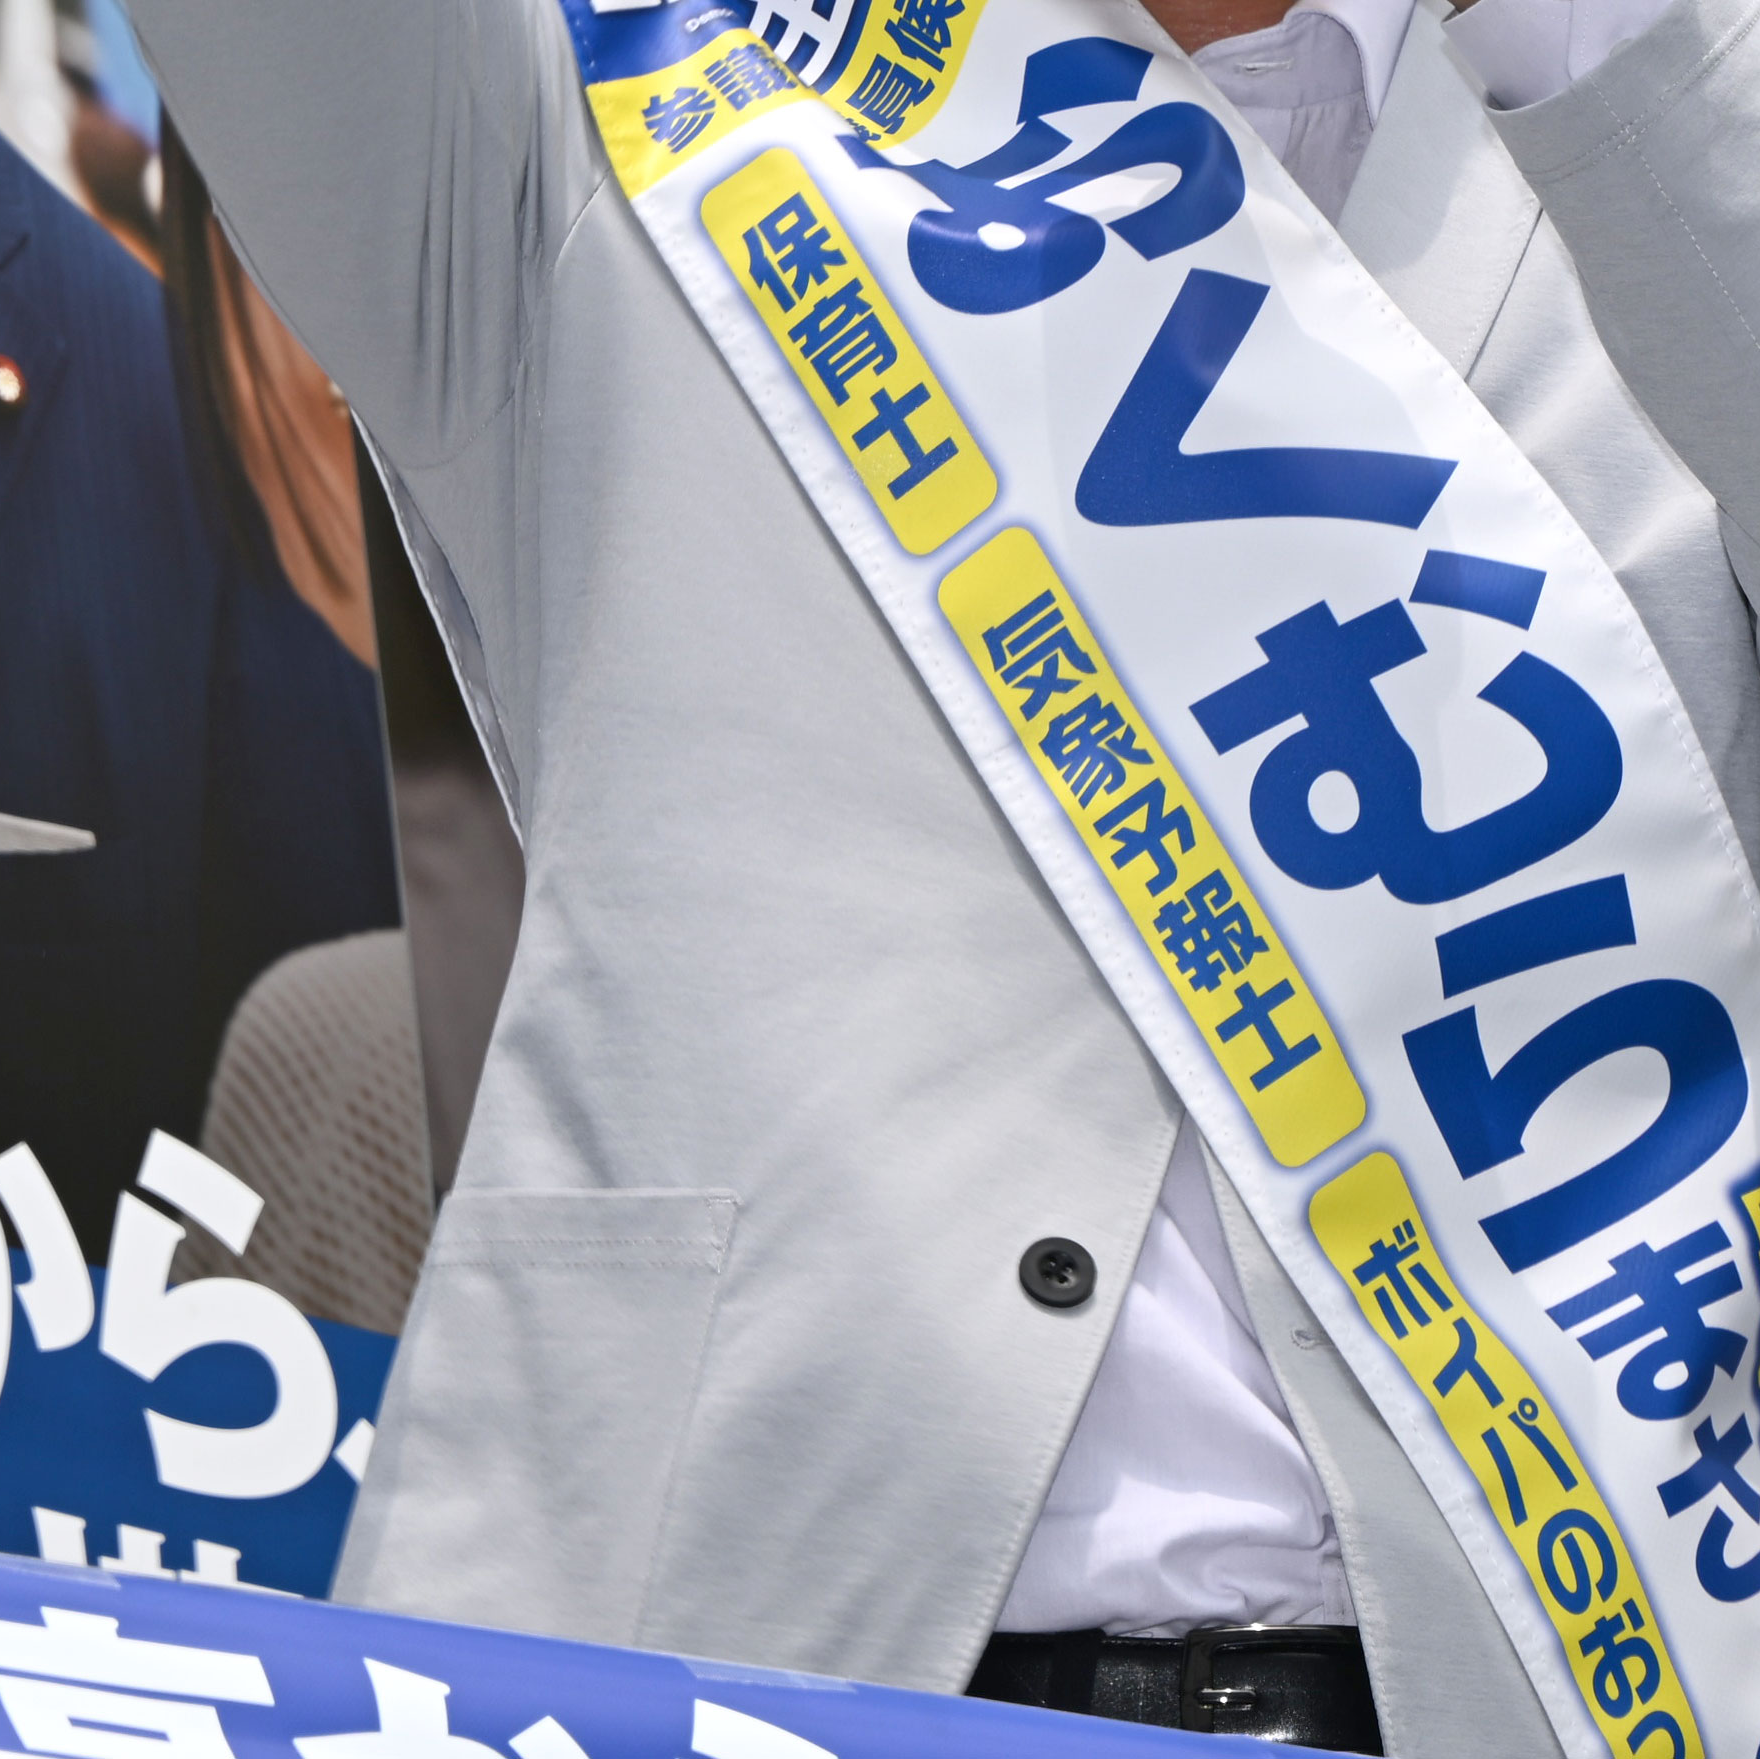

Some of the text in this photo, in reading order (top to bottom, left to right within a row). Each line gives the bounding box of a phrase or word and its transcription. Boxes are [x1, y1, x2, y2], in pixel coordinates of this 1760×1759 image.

[742, 192, 959, 501] 保育士
[982, 588, 1322, 1093] 気象予報士
